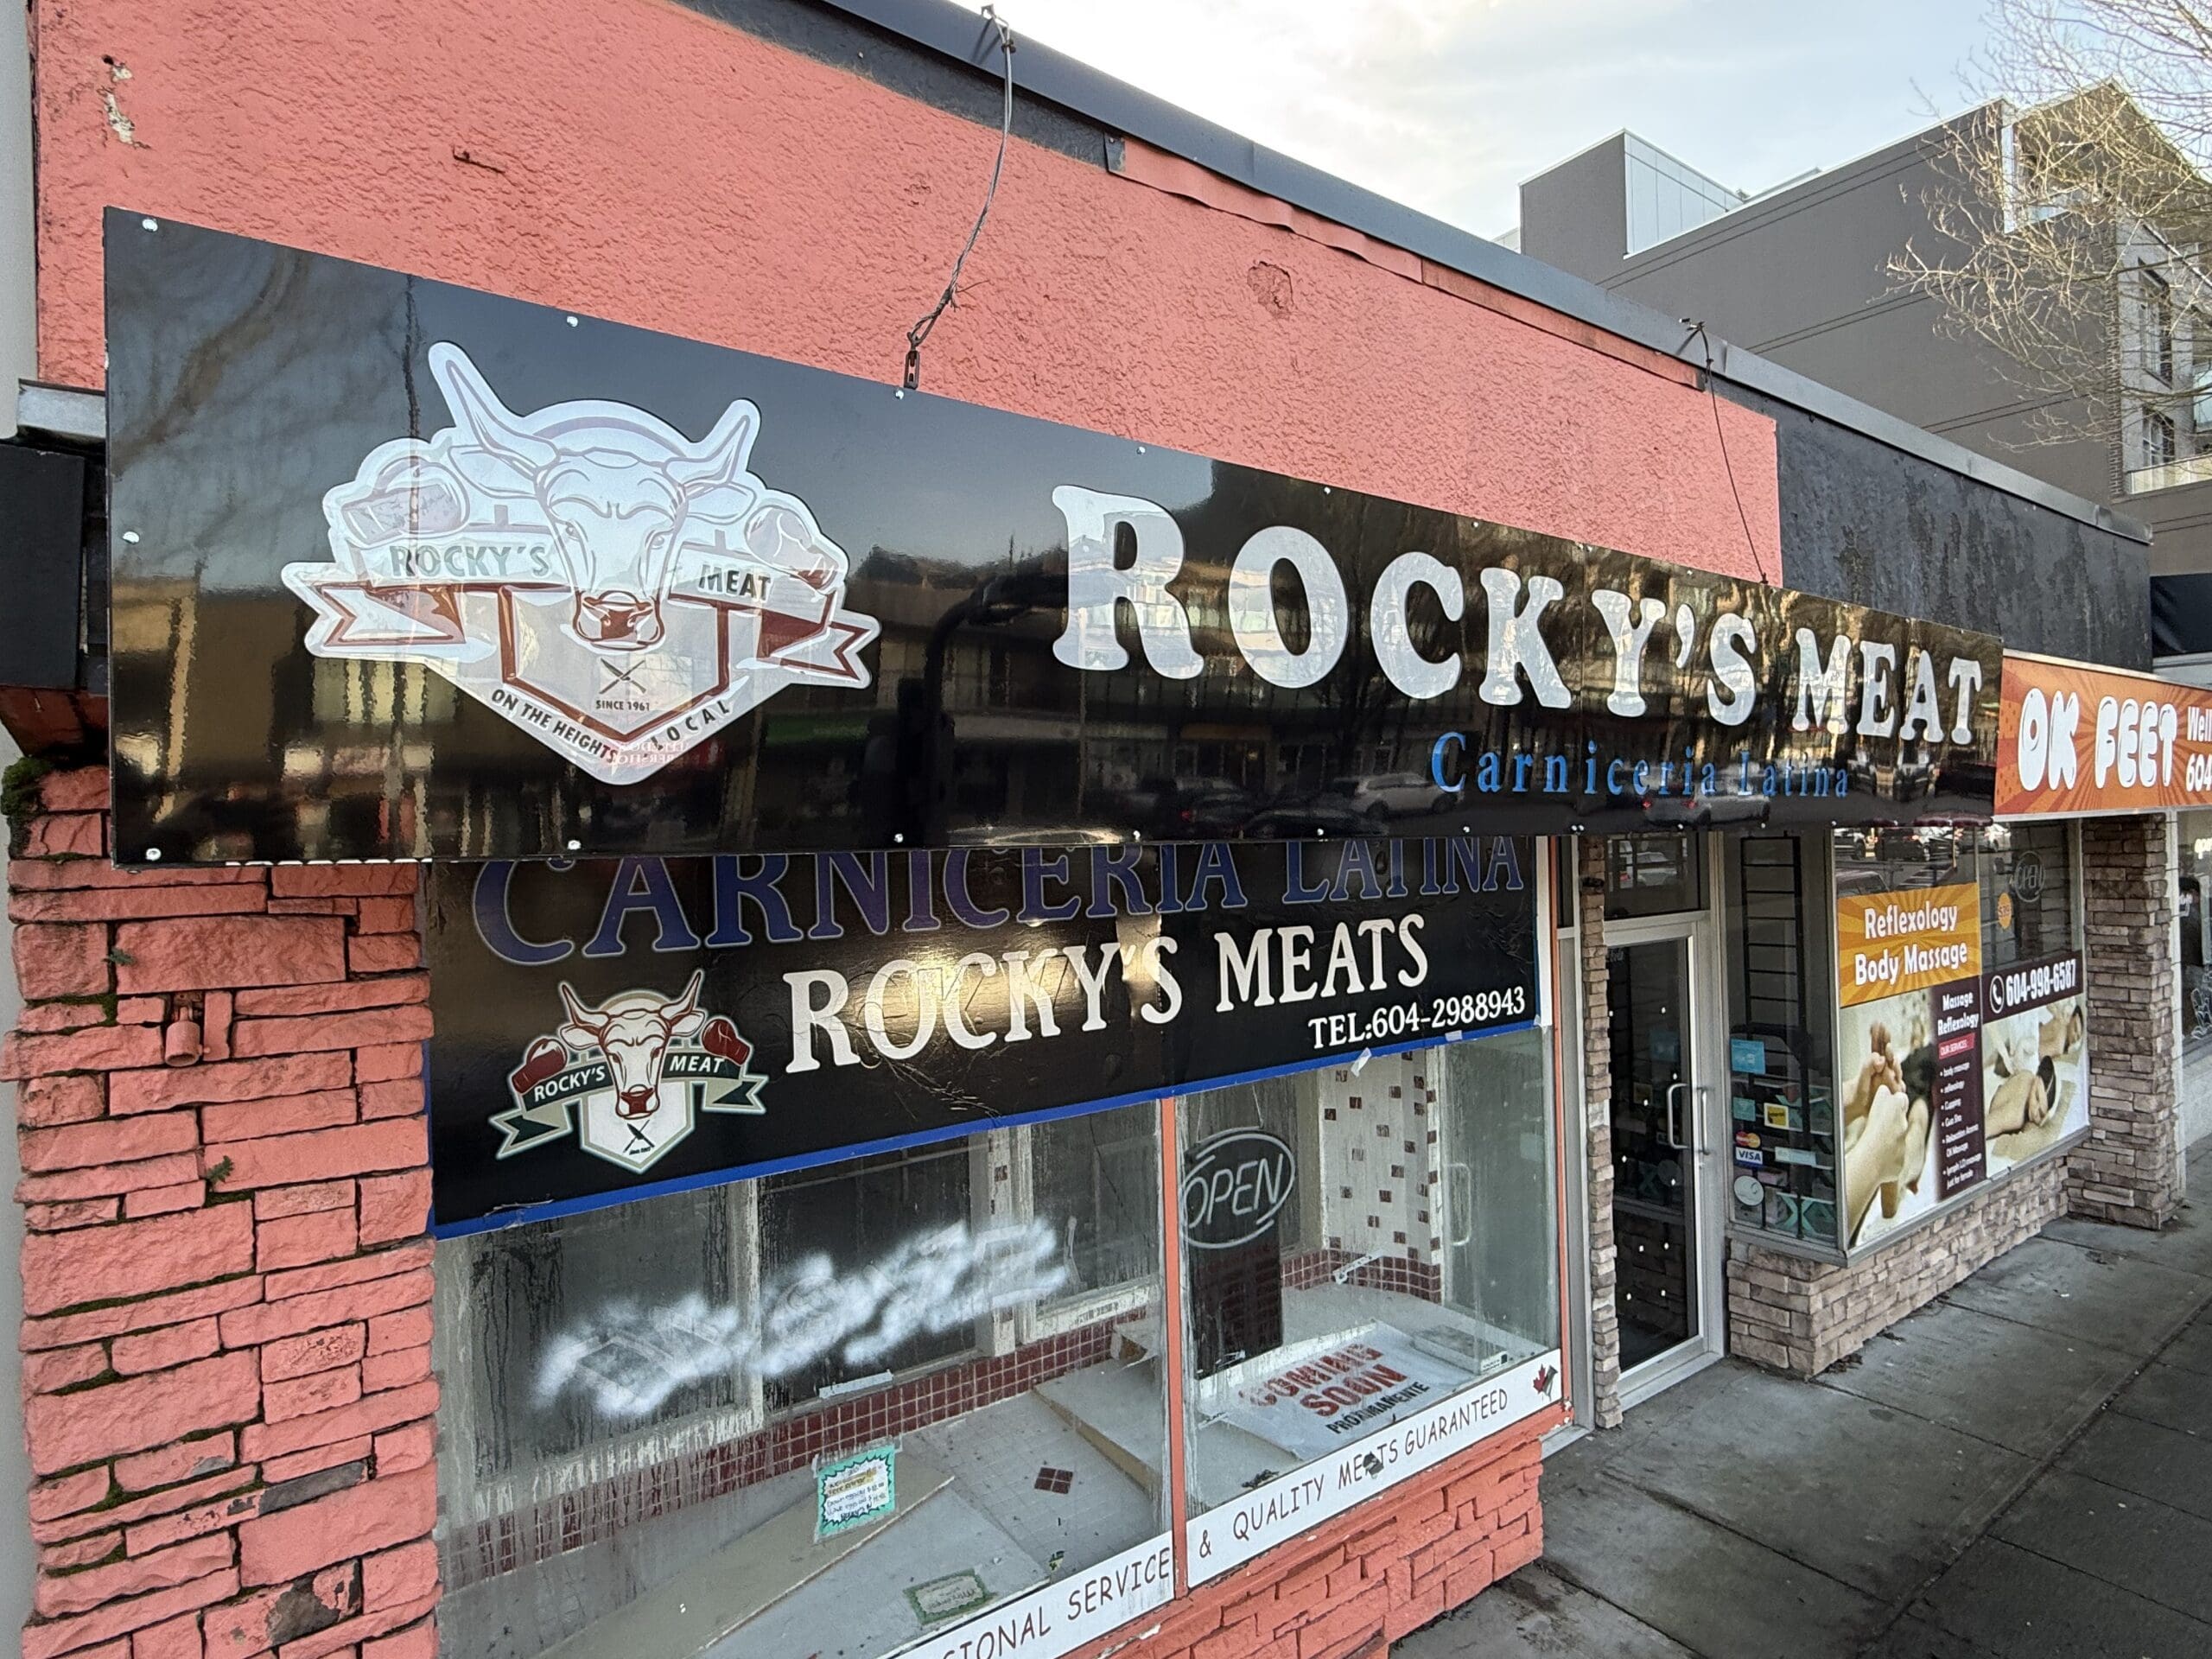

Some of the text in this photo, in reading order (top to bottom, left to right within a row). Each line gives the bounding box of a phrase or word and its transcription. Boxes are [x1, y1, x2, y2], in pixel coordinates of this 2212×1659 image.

[389, 544, 772, 602] ROCKY'S MEAT
[1052, 484, 1982, 745] ROCKY'S MEAT
[491, 689, 620, 764] ON THE HEIGHTS
[595, 699, 624, 711] SINCE
[1431, 731, 1849, 798] Carniceria Latina
[2018, 688, 2177, 791] OK FEET
[2186, 753, 2212, 791] 604
[1865, 900, 1958, 939] Reflexology
[1855, 942, 1968, 986] Body Massage
[2005, 958, 2076, 1007] 604-998-6587
[783, 913, 1428, 1074] ROCKY'S MEATS
[1942, 991, 1974, 1012] Massage
[1937, 1012, 1979, 1036] Reflexology
[534, 1055, 725, 1103] ROCKY'S MEAT
[1738, 1148, 1761, 1161] VISA
[1182, 1152, 1285, 1229] OPEN
[1300, 1363, 1408, 1417] SOON
[1067, 1546, 1170, 1621] SERVICE
[1199, 1529, 1211, 1559] &
[1232, 1474, 1325, 1541] QUALITY
[1338, 1439, 1399, 1491] METS
[1404, 1388, 1508, 1457] GUARANTEED
